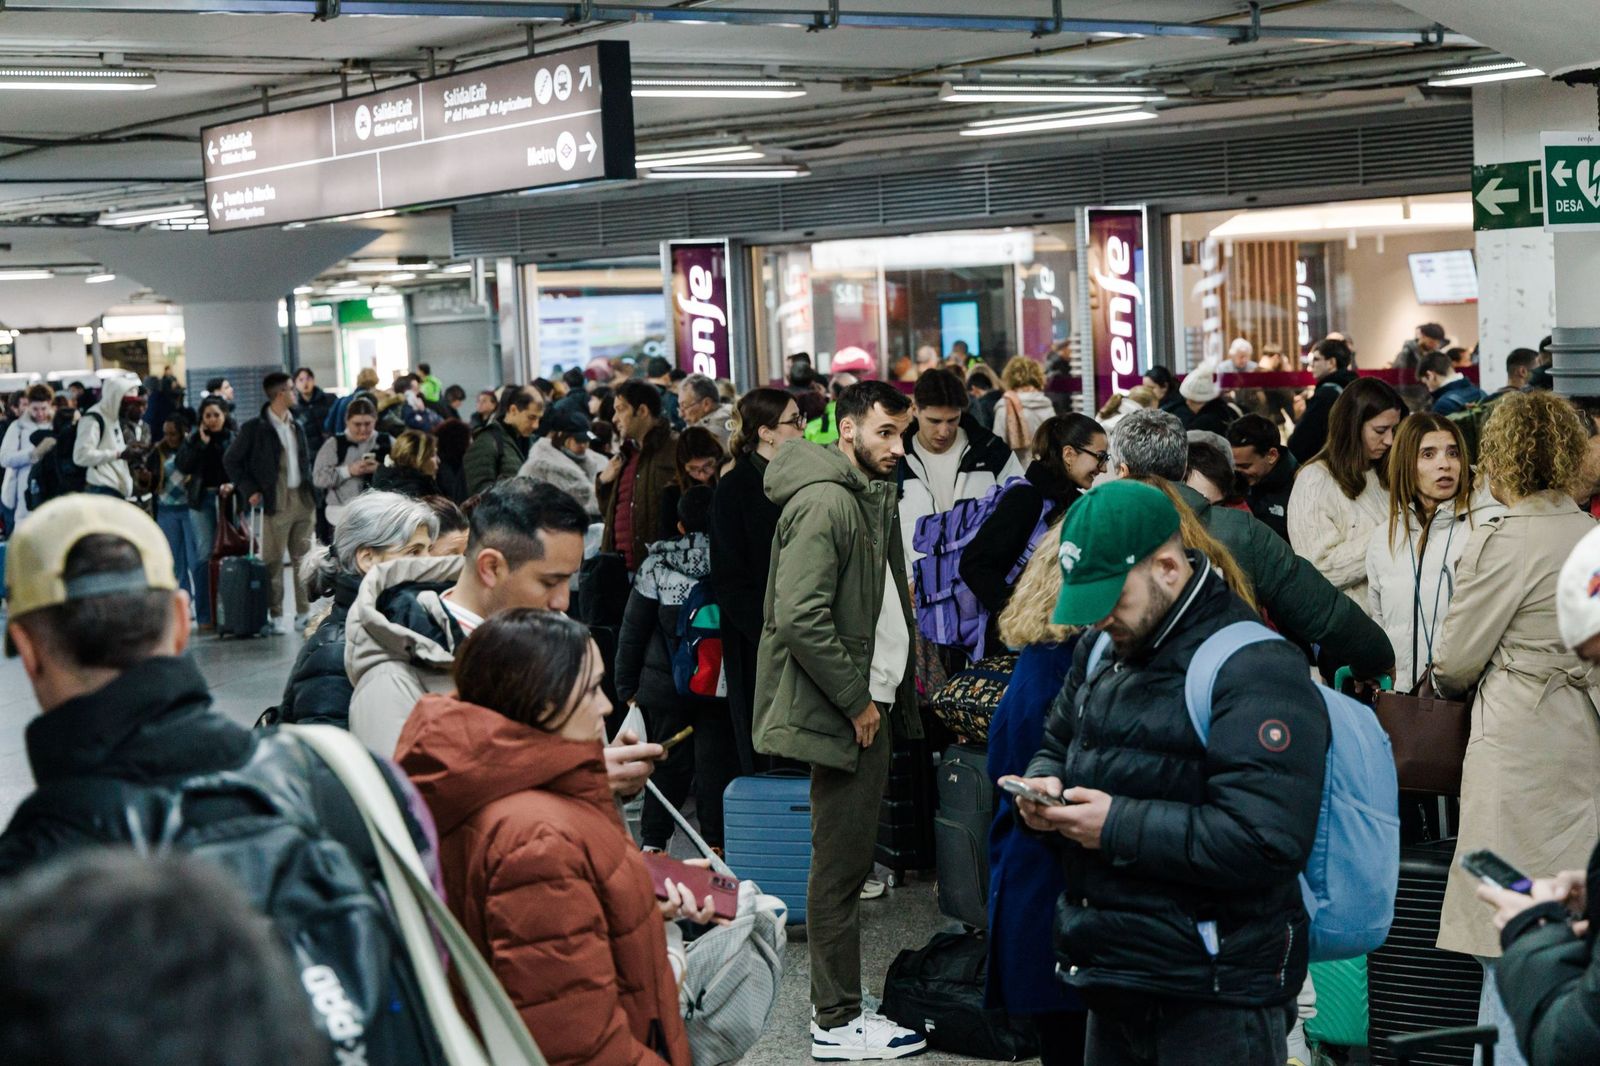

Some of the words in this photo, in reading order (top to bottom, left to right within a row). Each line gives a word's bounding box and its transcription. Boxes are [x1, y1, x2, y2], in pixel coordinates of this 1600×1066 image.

[444, 82, 487, 107] Salida/Exit
[527, 146, 556, 166] Metro
[1555, 199, 1585, 212] DESA
[677, 265, 727, 380] enfe
[1094, 235, 1143, 398] renfe
